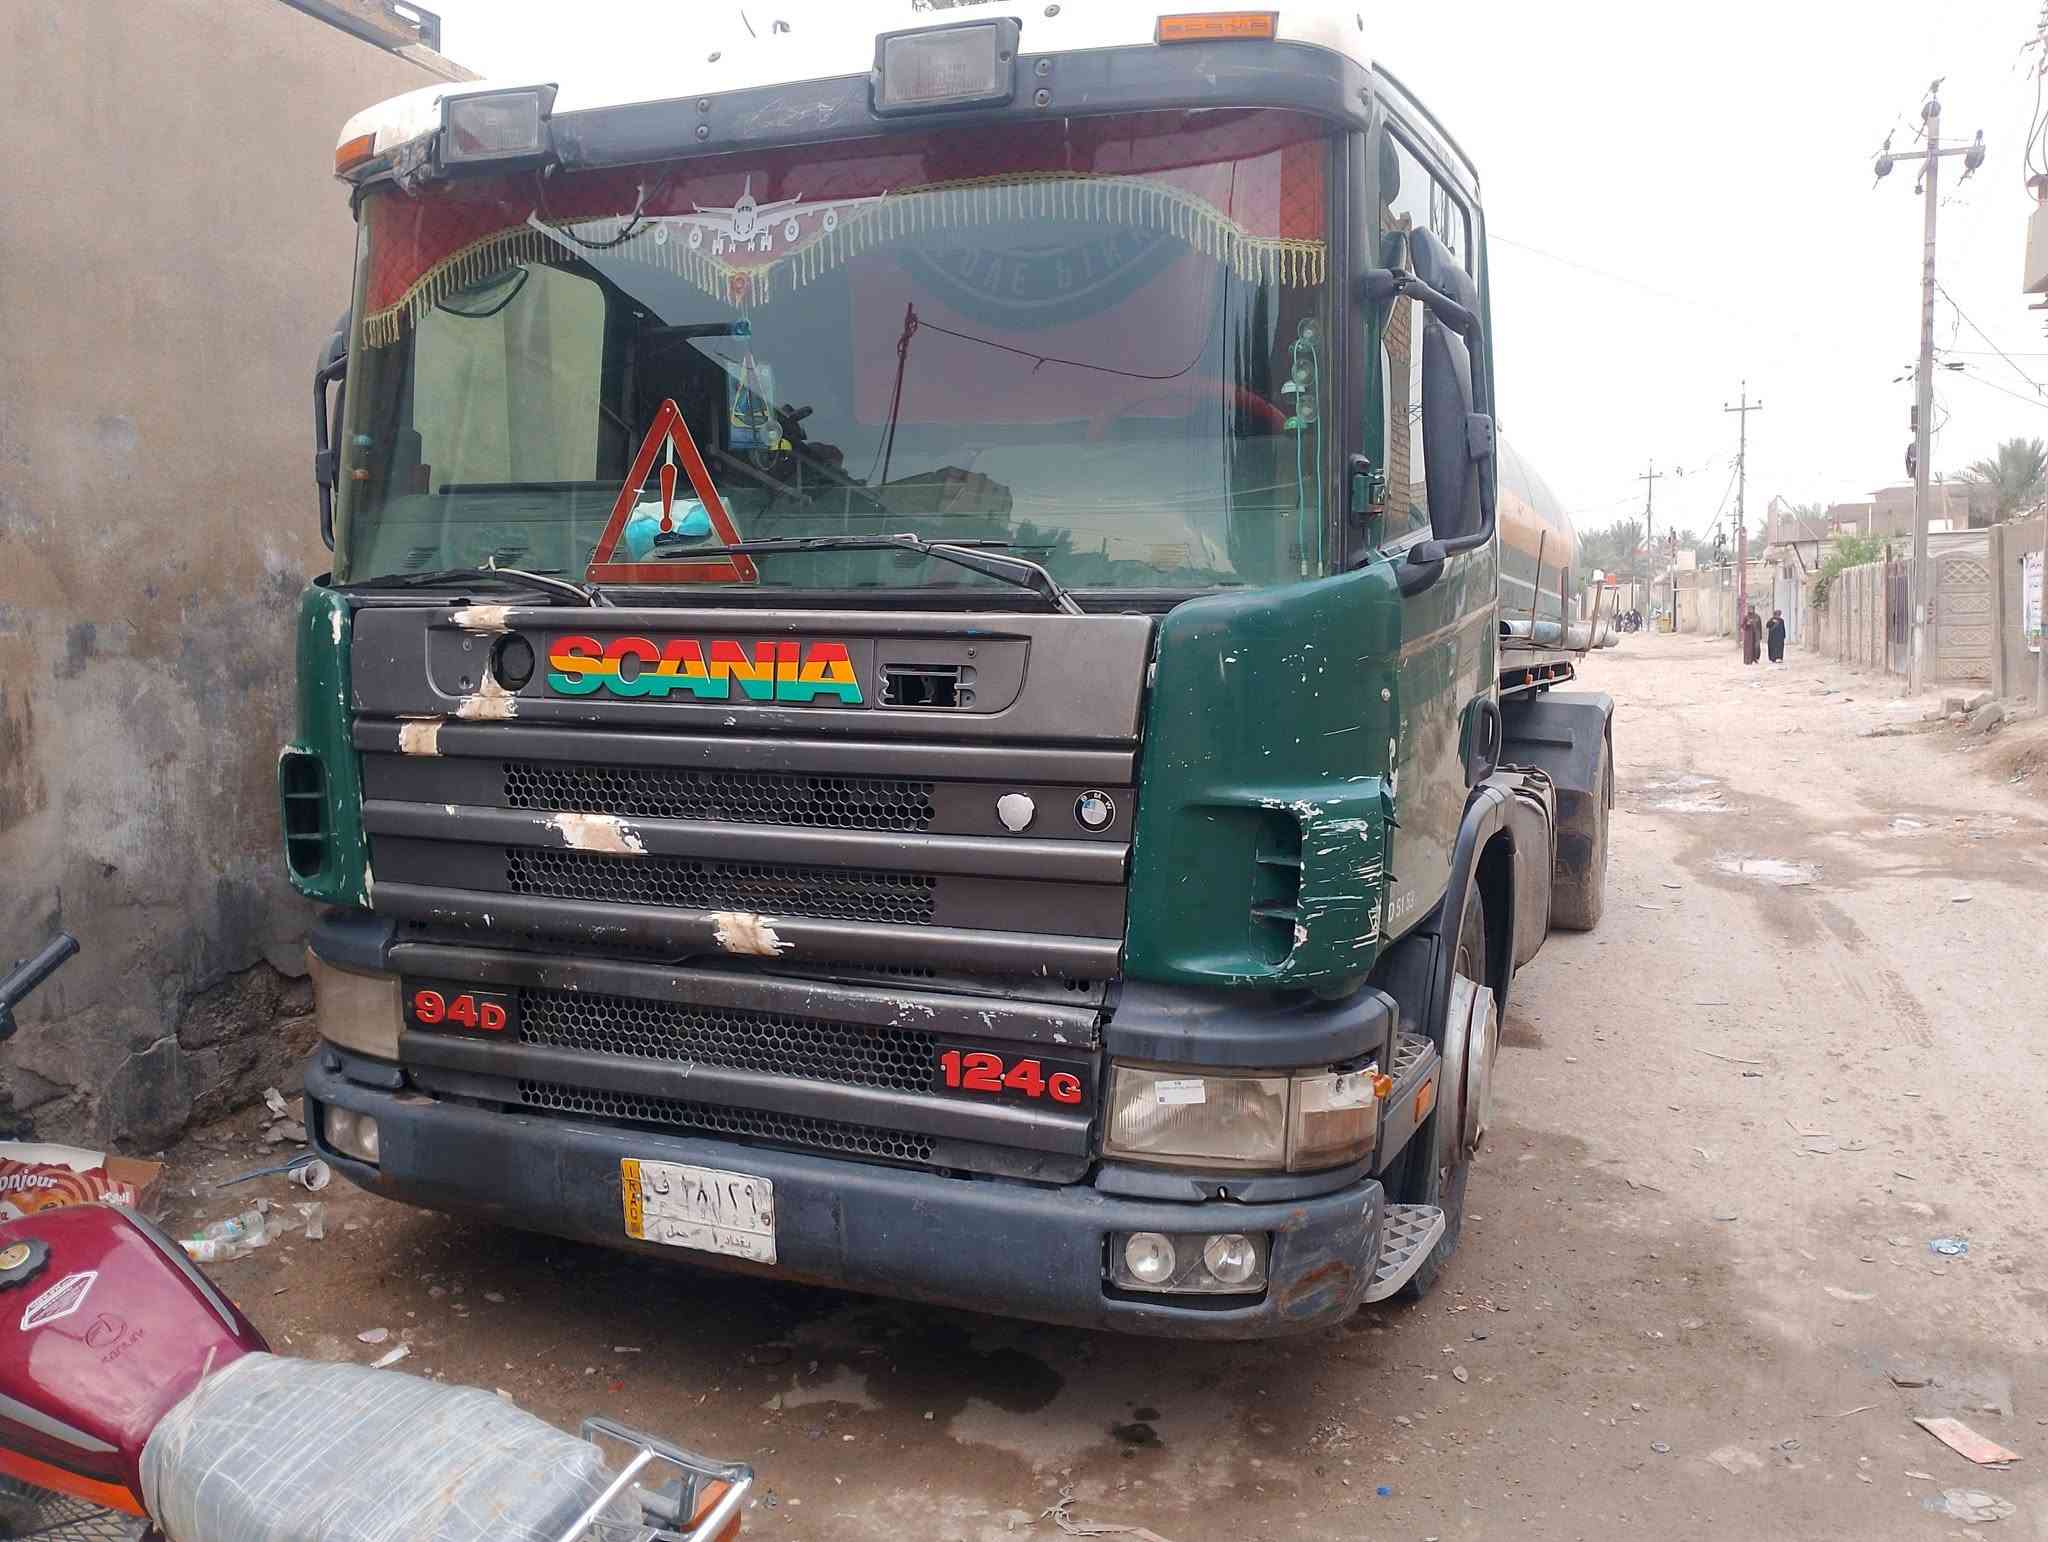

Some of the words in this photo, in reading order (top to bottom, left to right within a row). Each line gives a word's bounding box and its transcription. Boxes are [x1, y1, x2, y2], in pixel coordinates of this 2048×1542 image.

[547, 636, 865, 704] SCANIA
[415, 990, 507, 1031] 94D
[941, 1050, 1082, 1104] 124G
